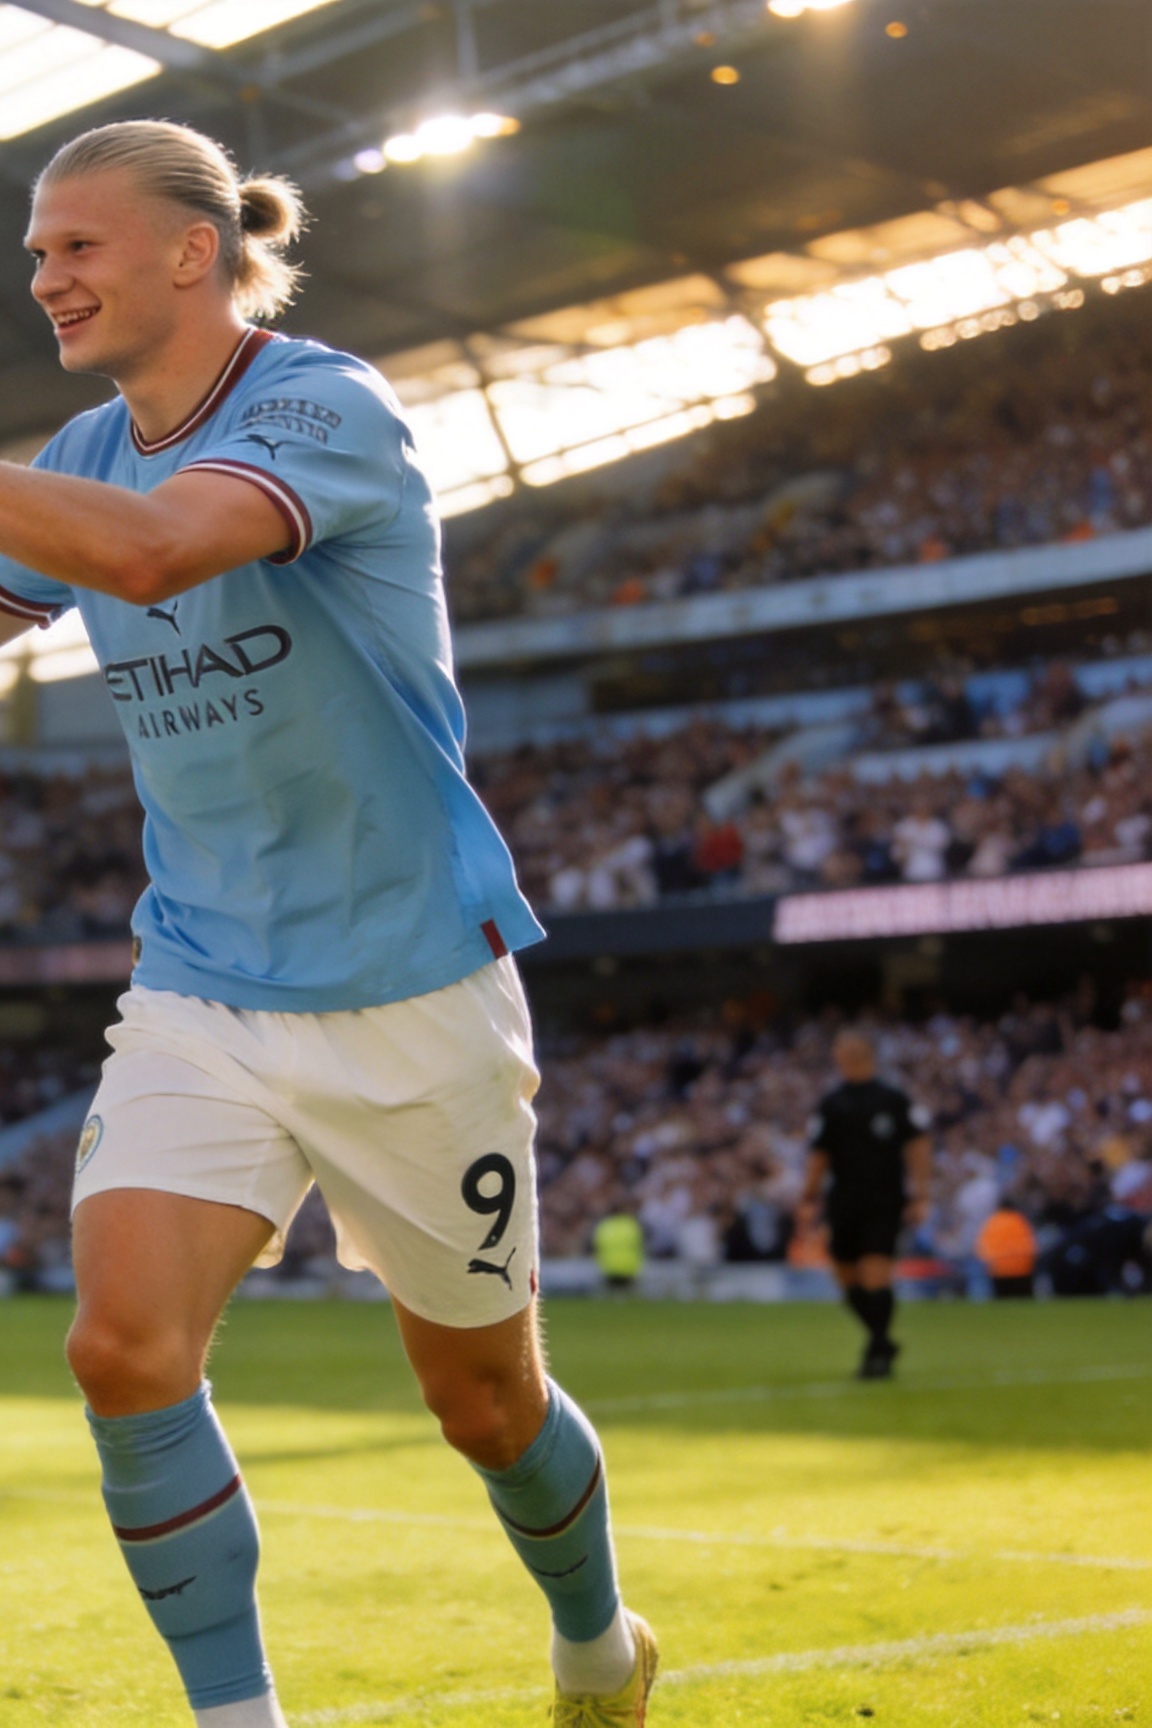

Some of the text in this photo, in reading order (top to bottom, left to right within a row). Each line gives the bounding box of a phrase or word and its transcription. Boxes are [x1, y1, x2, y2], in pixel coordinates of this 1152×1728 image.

[104, 625, 293, 702] ETIHAD
[137, 688, 265, 740] AIRWAYS
[461, 1152, 516, 1251] 9
